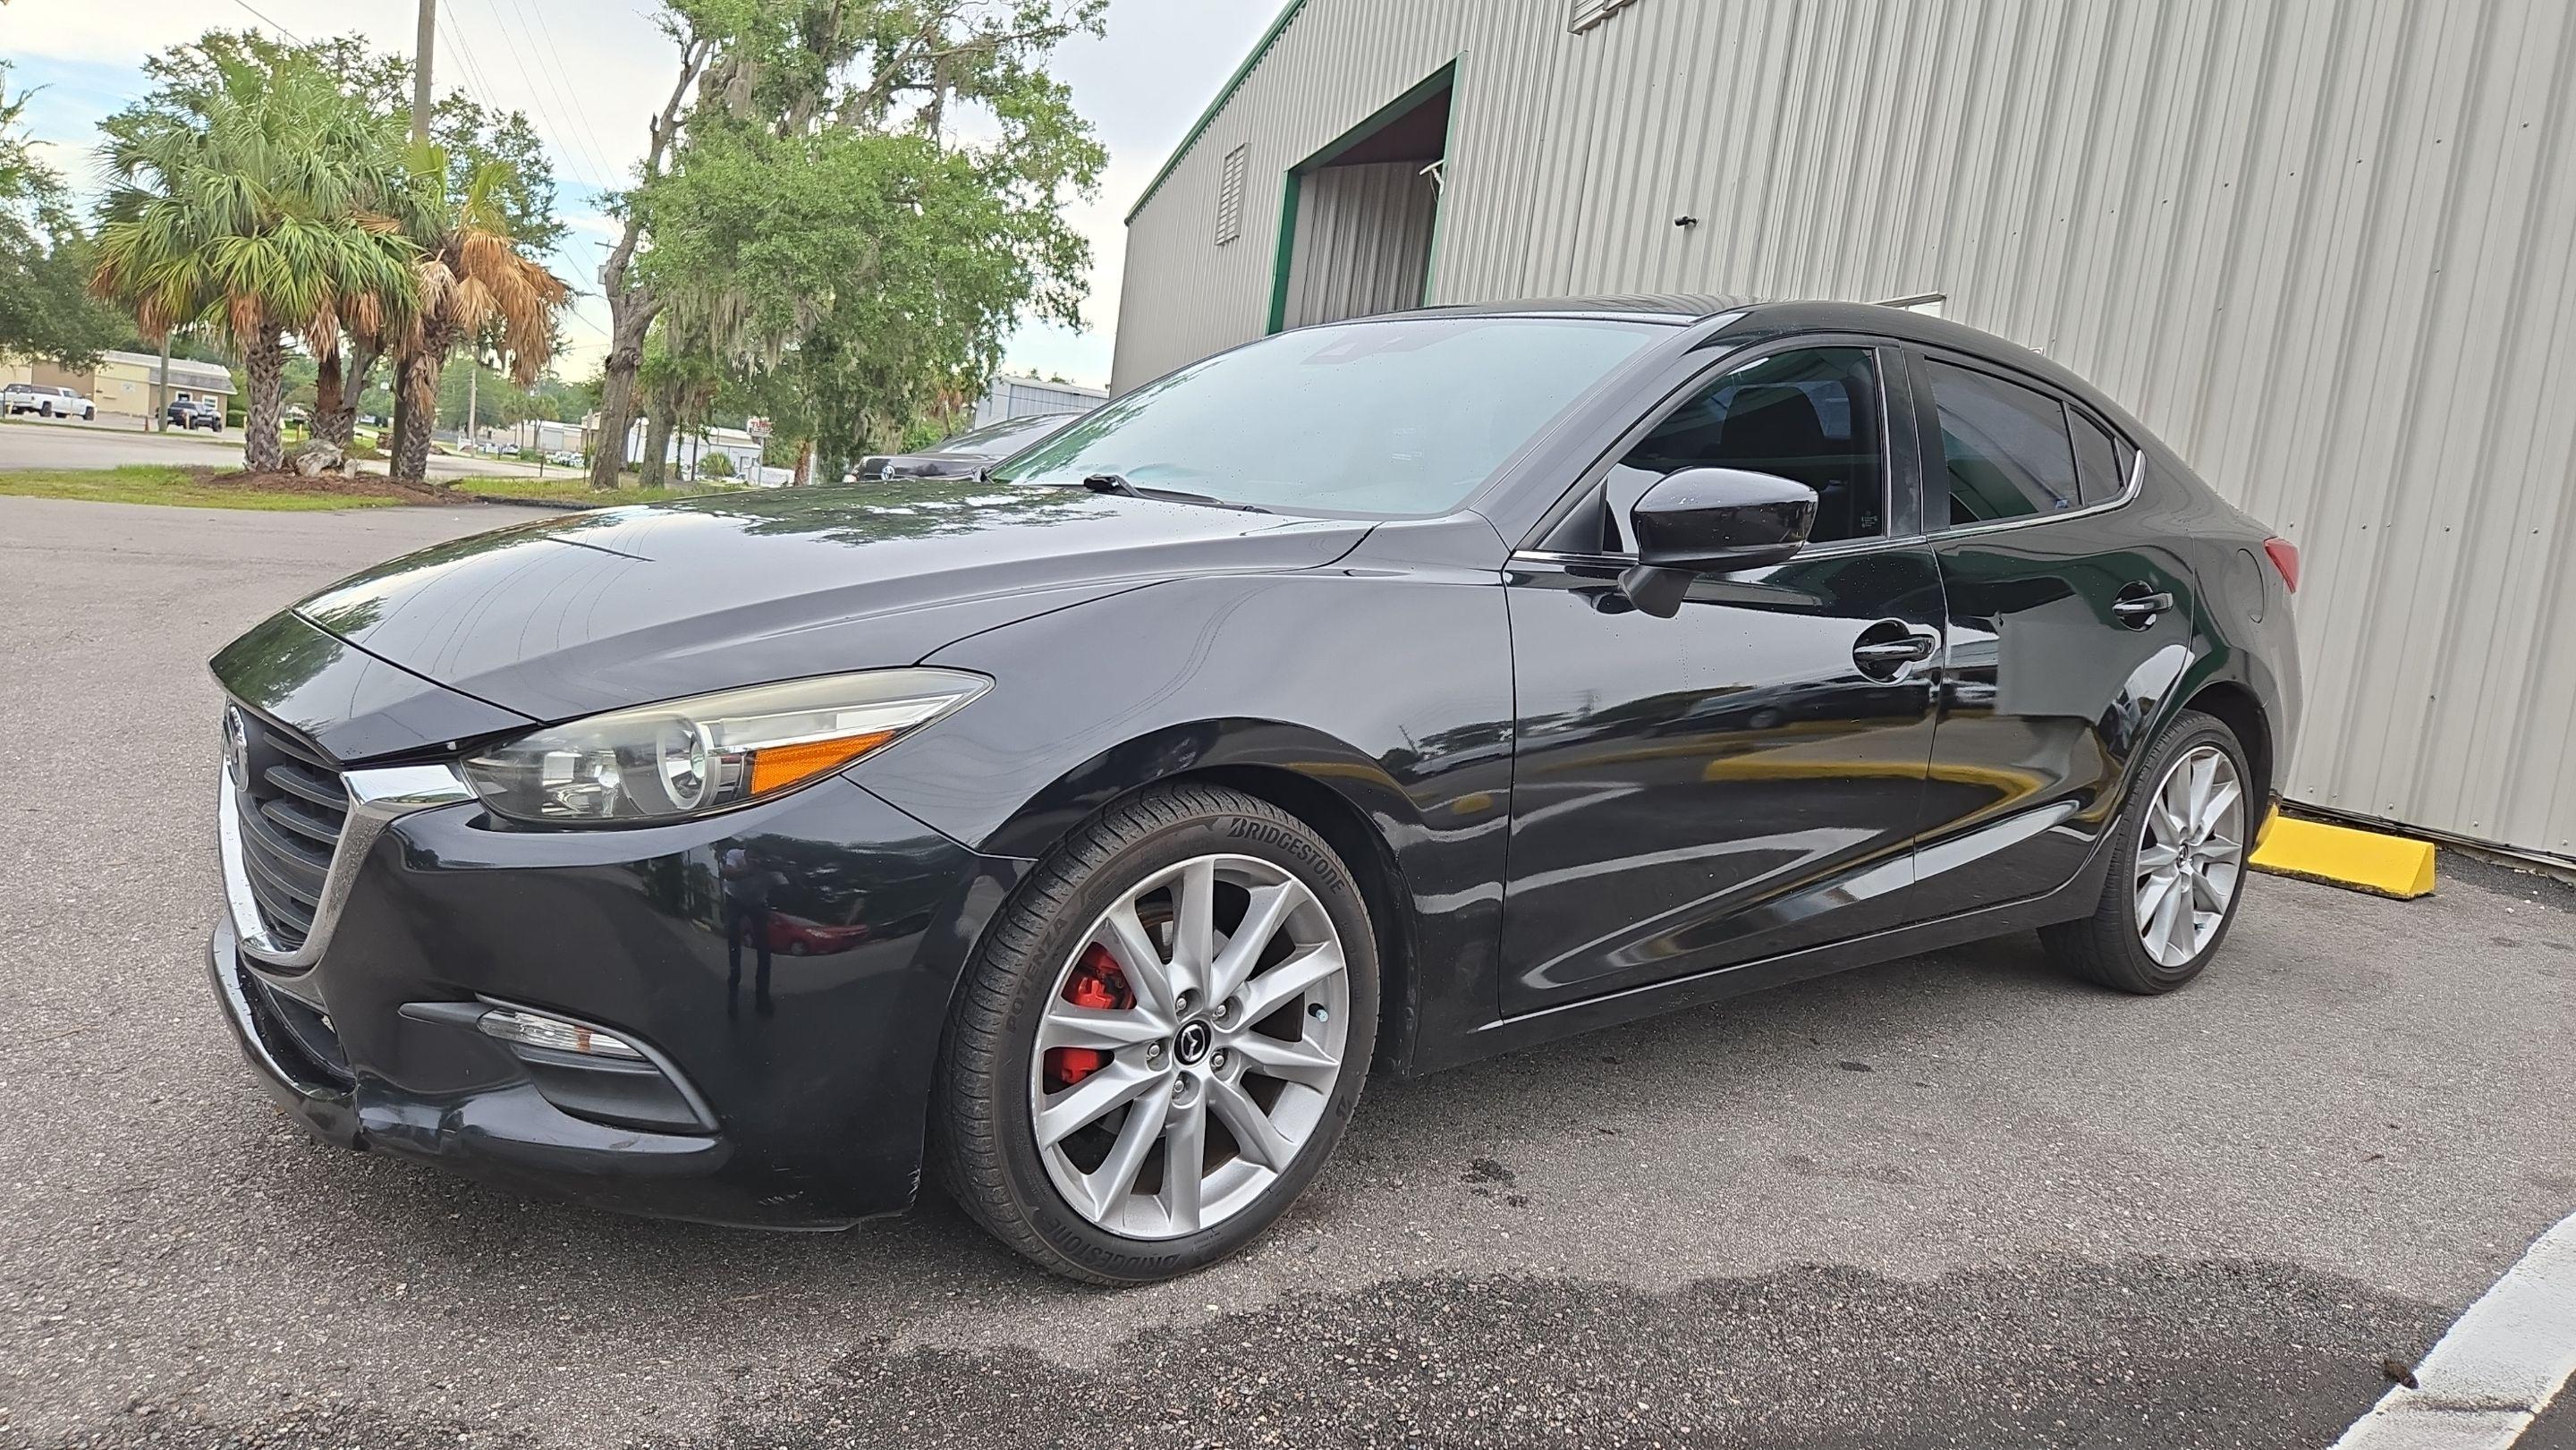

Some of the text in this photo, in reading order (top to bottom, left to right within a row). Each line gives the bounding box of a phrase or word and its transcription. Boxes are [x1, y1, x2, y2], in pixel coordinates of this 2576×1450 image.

[1226, 818, 1345, 895] BRIDGESTONE
[1006, 918, 1068, 1030] POTENZA
[1042, 1217, 1181, 1269] BRIDGESTONE
